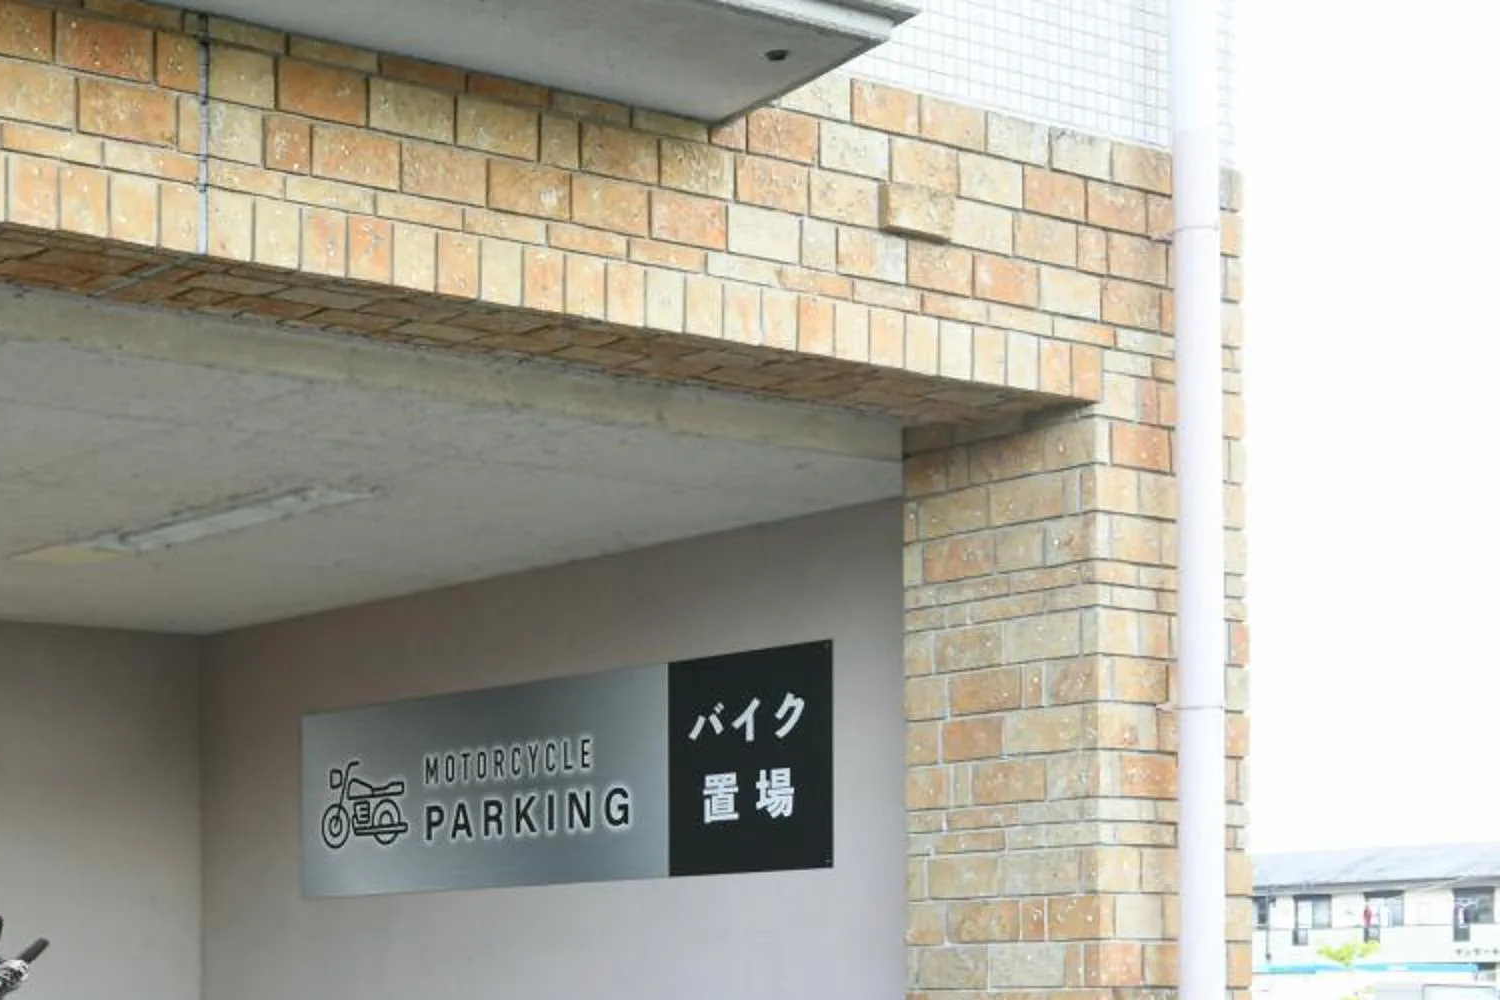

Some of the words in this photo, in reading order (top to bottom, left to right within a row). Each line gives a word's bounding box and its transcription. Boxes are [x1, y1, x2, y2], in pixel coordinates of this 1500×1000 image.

[688, 691, 806, 743] バイク
[425, 738, 591, 785] MOTORCYCLE
[425, 787, 629, 841] PARKING
[702, 767, 795, 825] 置場
